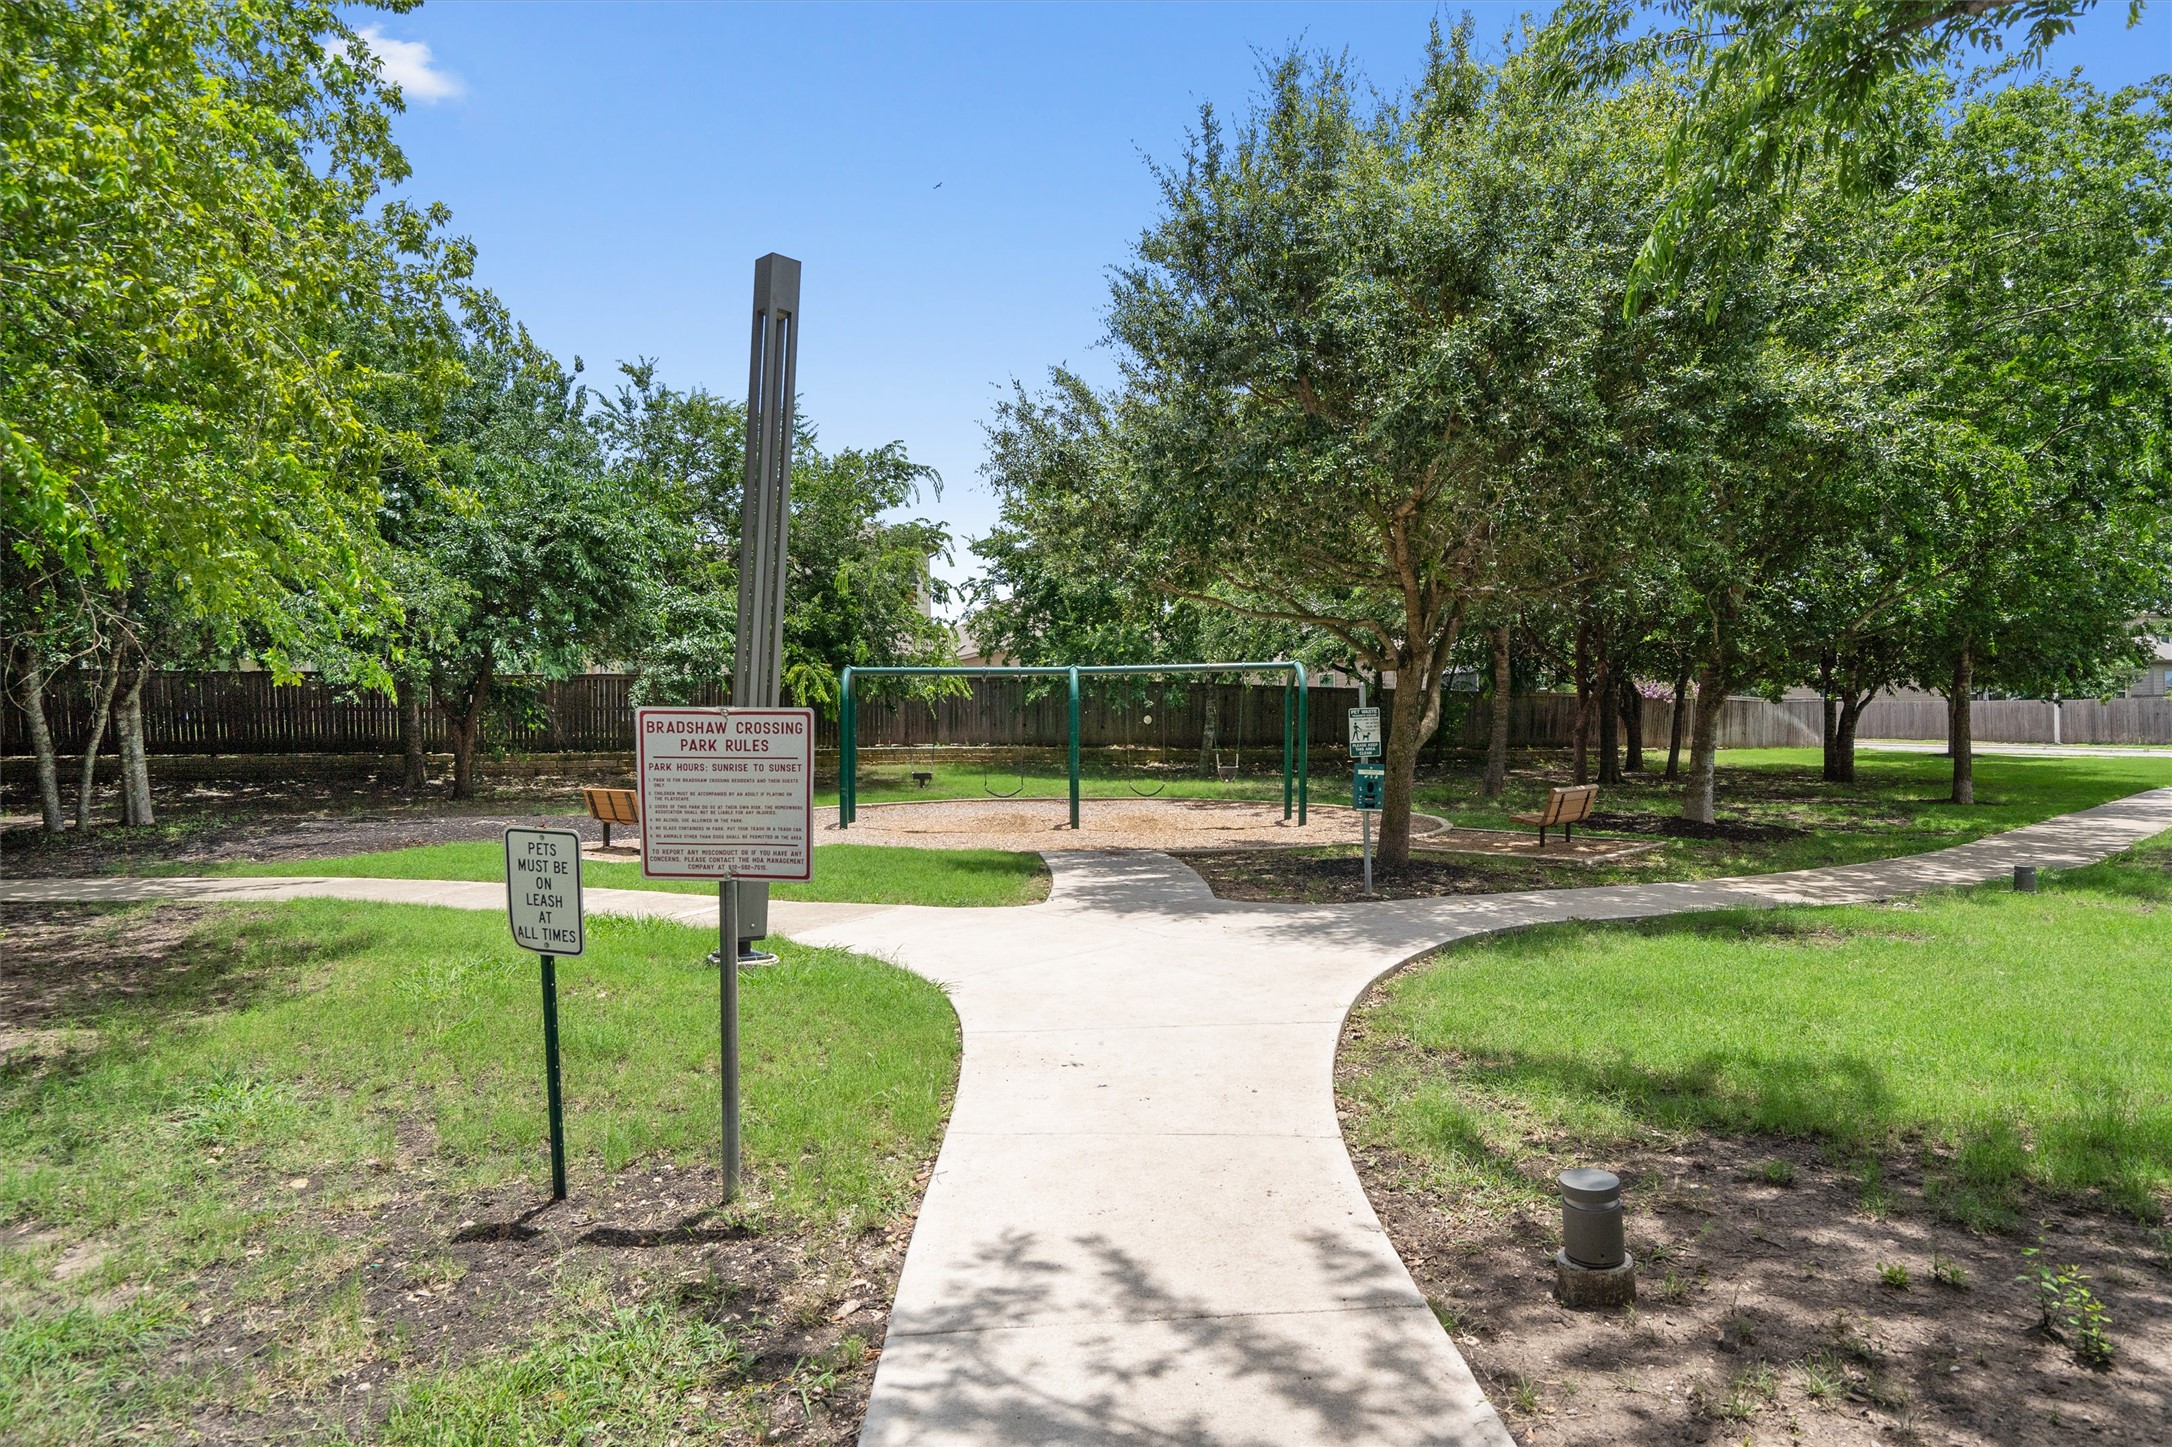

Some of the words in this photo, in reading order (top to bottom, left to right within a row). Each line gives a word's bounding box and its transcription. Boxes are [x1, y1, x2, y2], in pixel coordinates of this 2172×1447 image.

[646, 721, 727, 734] BRADSHAW
[736, 722, 803, 734] CROSSING
[680, 739, 717, 751] PARK
[725, 740, 769, 752] RULES
[769, 764, 802, 772] SUNSET
[528, 842, 556, 856] PETS
[518, 859, 548, 872] MUST
[554, 861, 568, 874] BE
[536, 877, 551, 890] ON
[526, 893, 563, 908] LEASH
[539, 911, 551, 924] AT
[518, 926, 538, 939] ALL
[542, 928, 576, 943] TIMES
